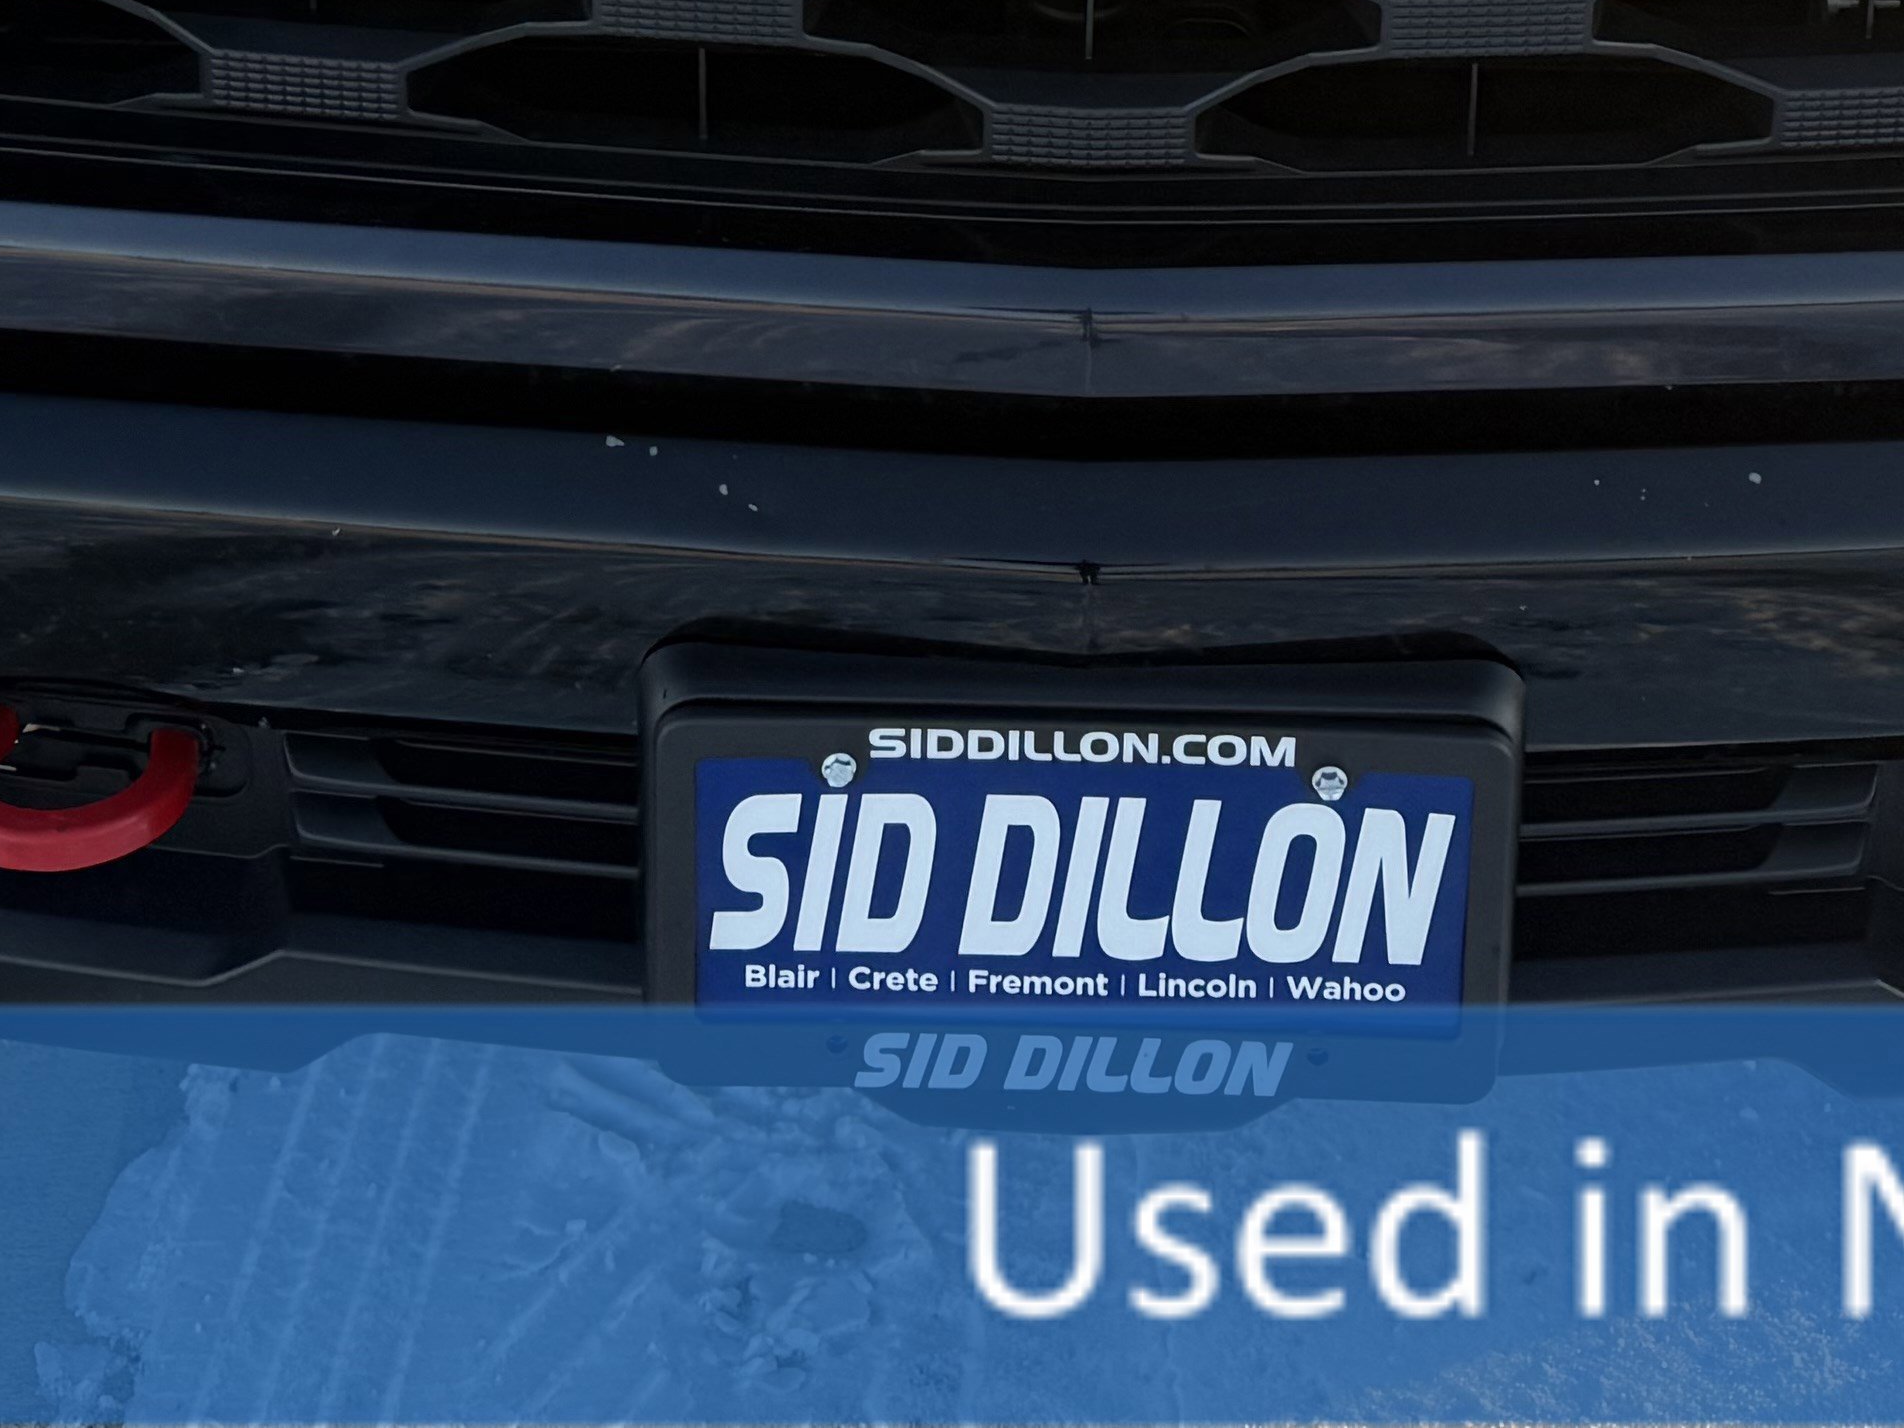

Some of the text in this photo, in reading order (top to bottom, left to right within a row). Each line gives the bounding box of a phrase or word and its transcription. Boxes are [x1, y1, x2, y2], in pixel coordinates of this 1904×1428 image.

[867, 726, 1297, 768] SIDDILLON.COM
[708, 790, 1457, 966] SID DILLON
[744, 963, 1407, 1003] Blair Crete Fremont Lincoln Wahoo
[853, 1031, 1295, 1098] SID DILLON
